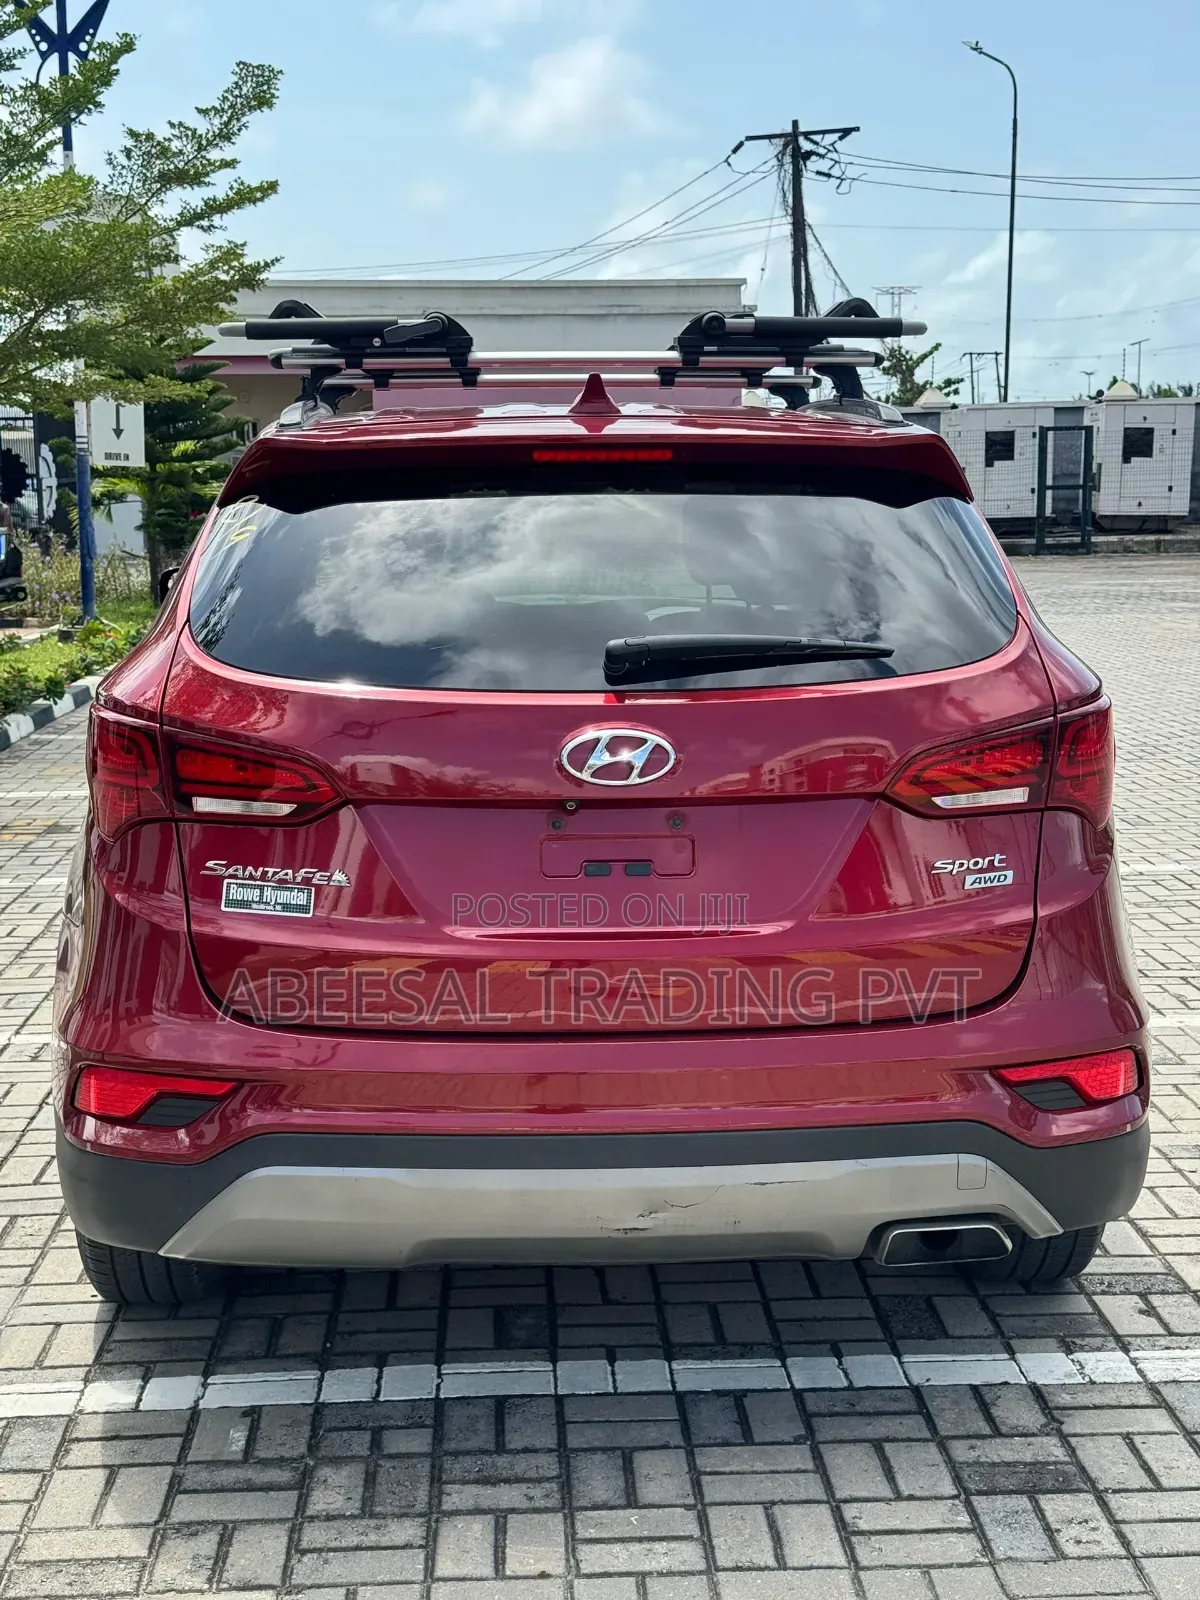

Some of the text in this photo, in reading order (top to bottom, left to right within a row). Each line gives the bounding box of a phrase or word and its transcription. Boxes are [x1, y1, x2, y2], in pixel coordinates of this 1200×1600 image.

[104, 452, 130, 461] DRIVE IN
[931, 853, 1006, 875] Sport
[969, 874, 1008, 887] AWD
[229, 885, 308, 905] Rowe Hyundai
